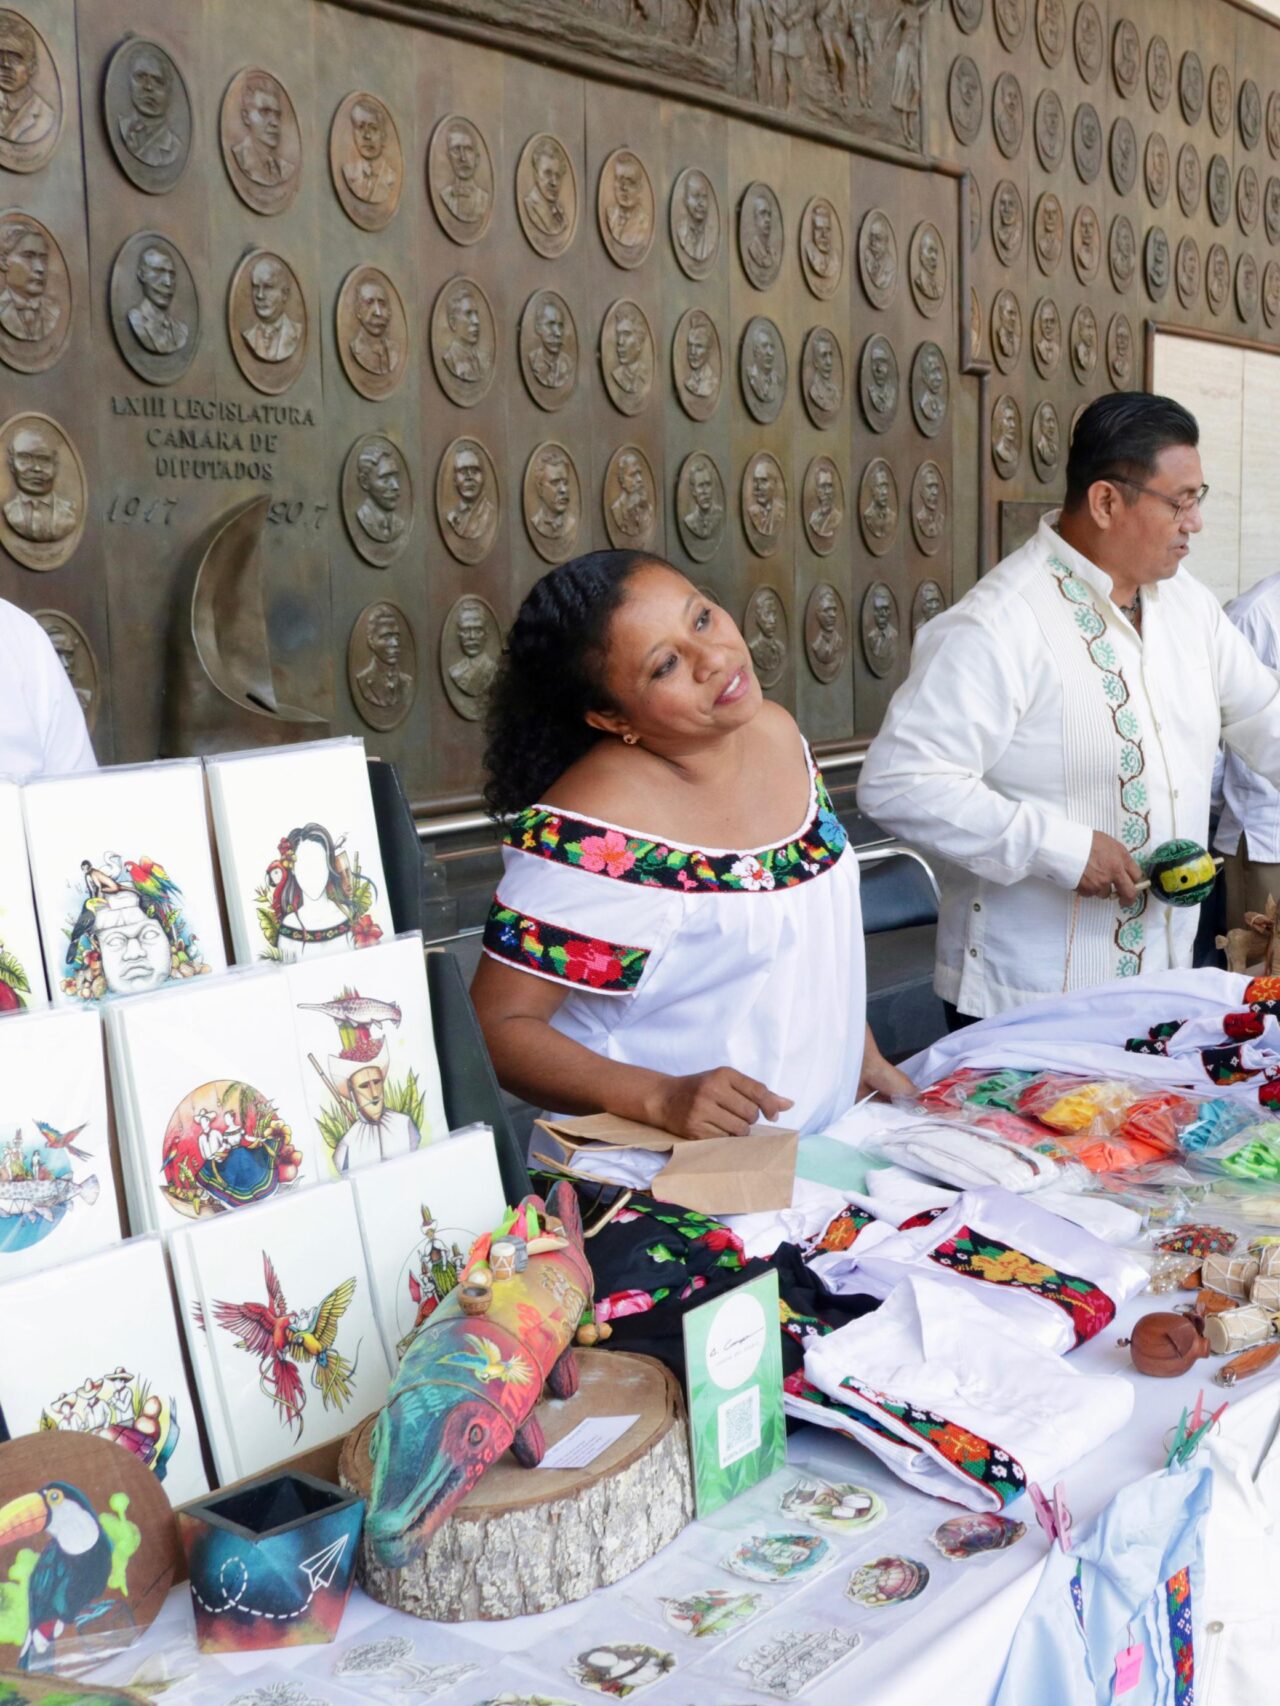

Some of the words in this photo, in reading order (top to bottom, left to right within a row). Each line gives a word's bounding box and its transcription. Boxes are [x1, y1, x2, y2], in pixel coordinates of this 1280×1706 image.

[111, 396, 166, 418] LXIII
[174, 398, 316, 427] LEGISLATURA
[251, 432, 279, 454] DE
[155, 455, 274, 482] DIPUTADOS
